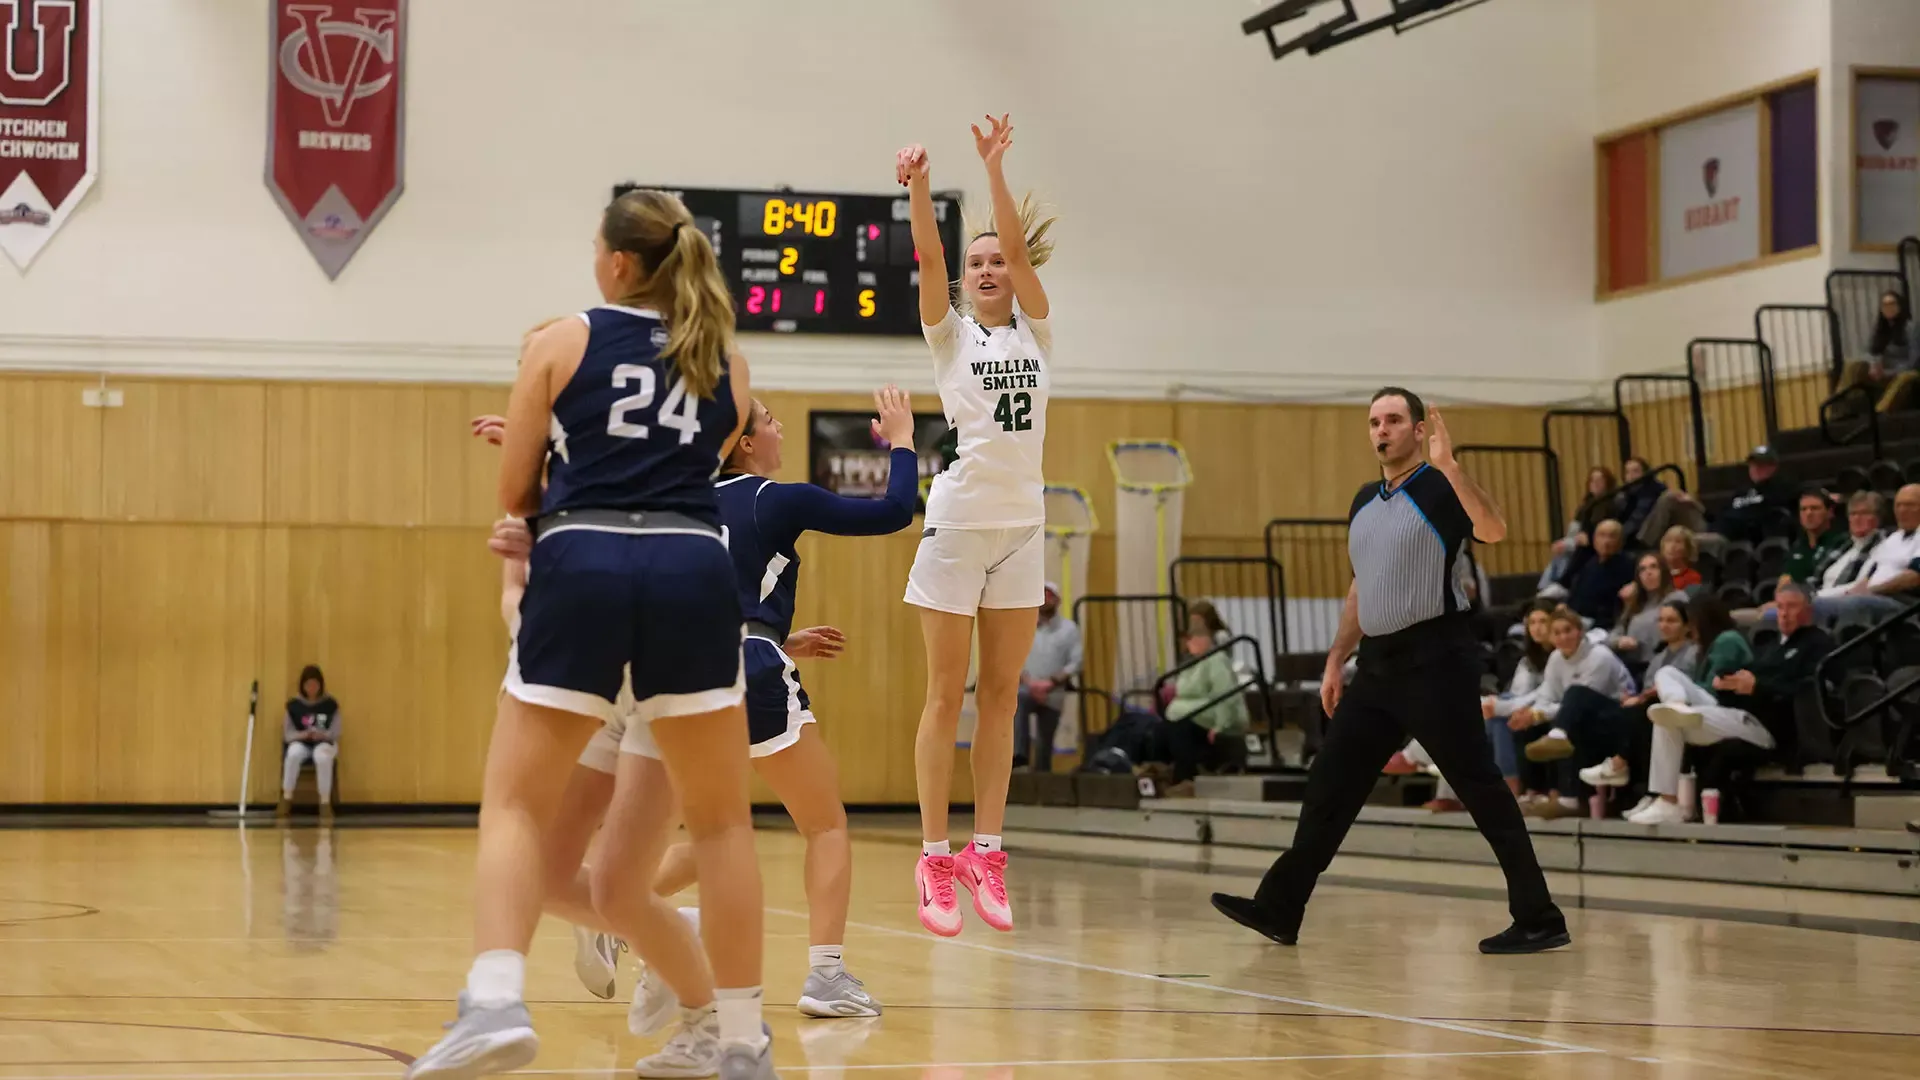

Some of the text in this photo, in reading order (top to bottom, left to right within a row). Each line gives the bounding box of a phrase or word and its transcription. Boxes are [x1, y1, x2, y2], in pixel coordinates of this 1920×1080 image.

[298, 130, 372, 152] BREWERS
[763, 199, 837, 237] 8:40
[780, 247, 799, 275] 2
[746, 285, 825, 314] 21 1
[858, 289, 876, 318] 5
[970, 358, 1041, 376] WILLIAM
[982, 374, 1038, 391] SMITH
[606, 363, 702, 446] 24
[993, 391, 1032, 432] 42
